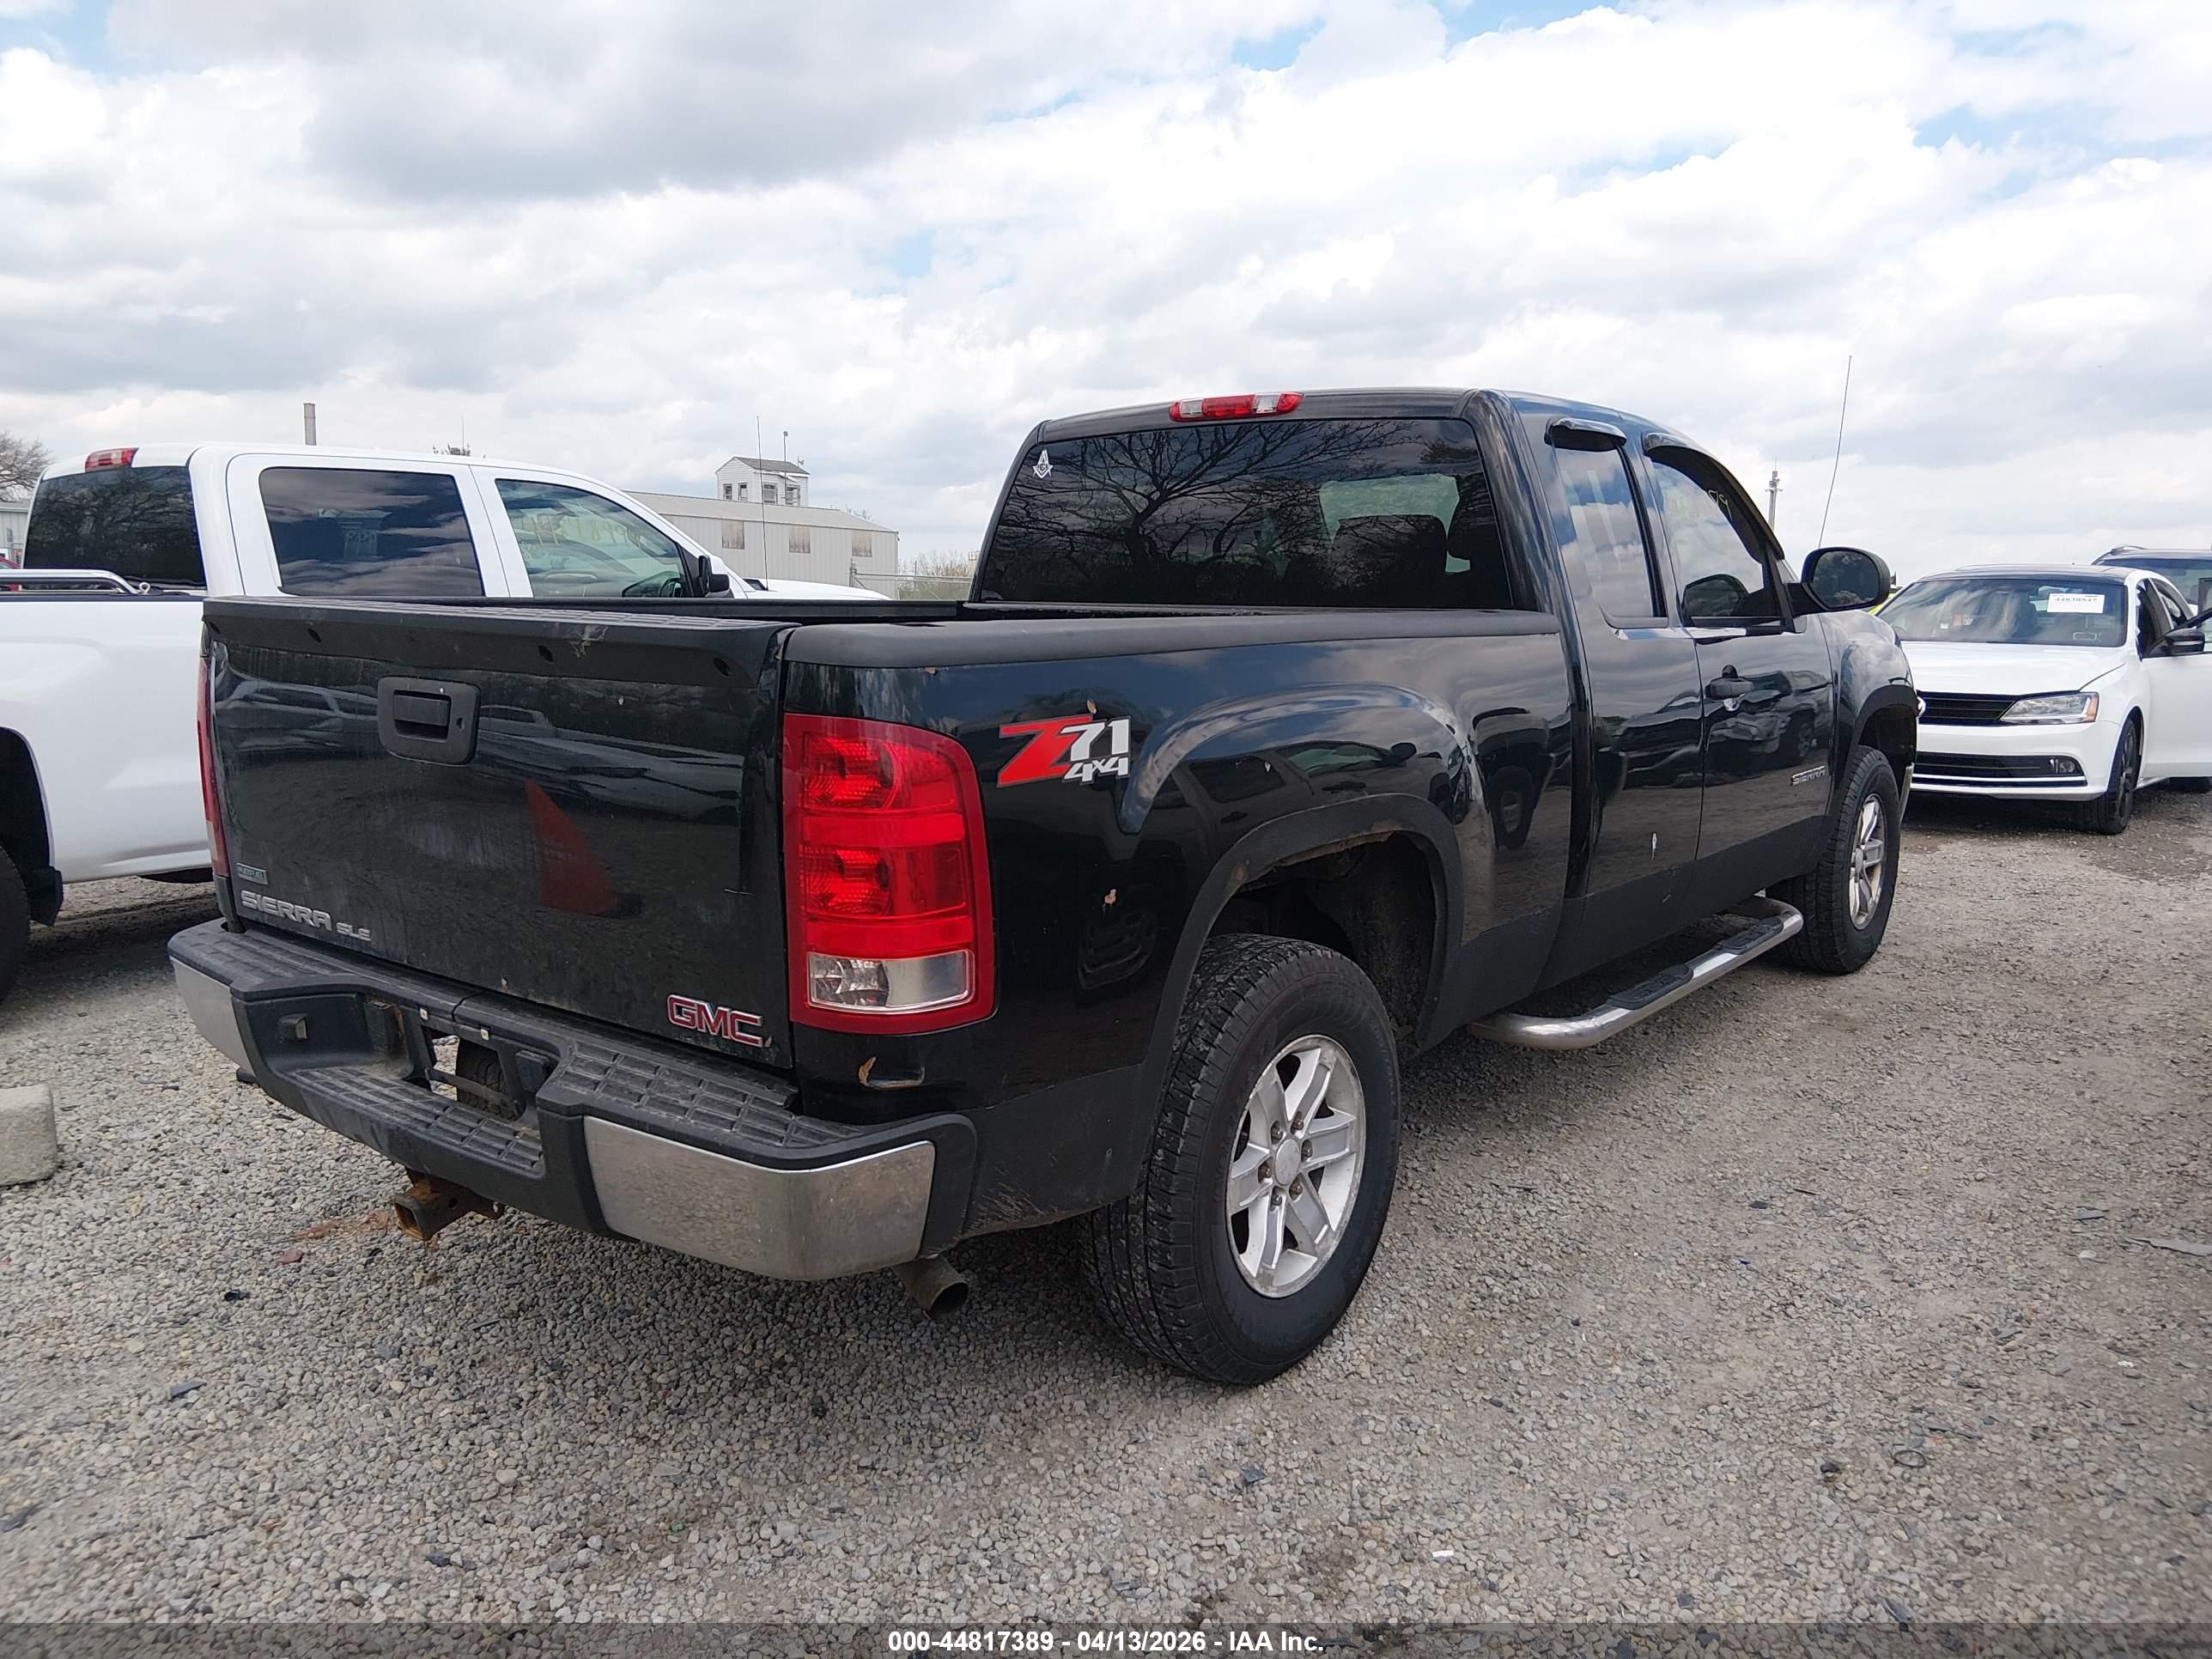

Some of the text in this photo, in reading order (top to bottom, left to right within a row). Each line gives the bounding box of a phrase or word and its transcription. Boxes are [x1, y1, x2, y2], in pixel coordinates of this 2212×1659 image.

[998, 714, 1130, 787] Z71
[1790, 765, 1826, 786] SIERRA
[240, 890, 371, 941] SIERRA SLE
[667, 994, 763, 1048] GMC
